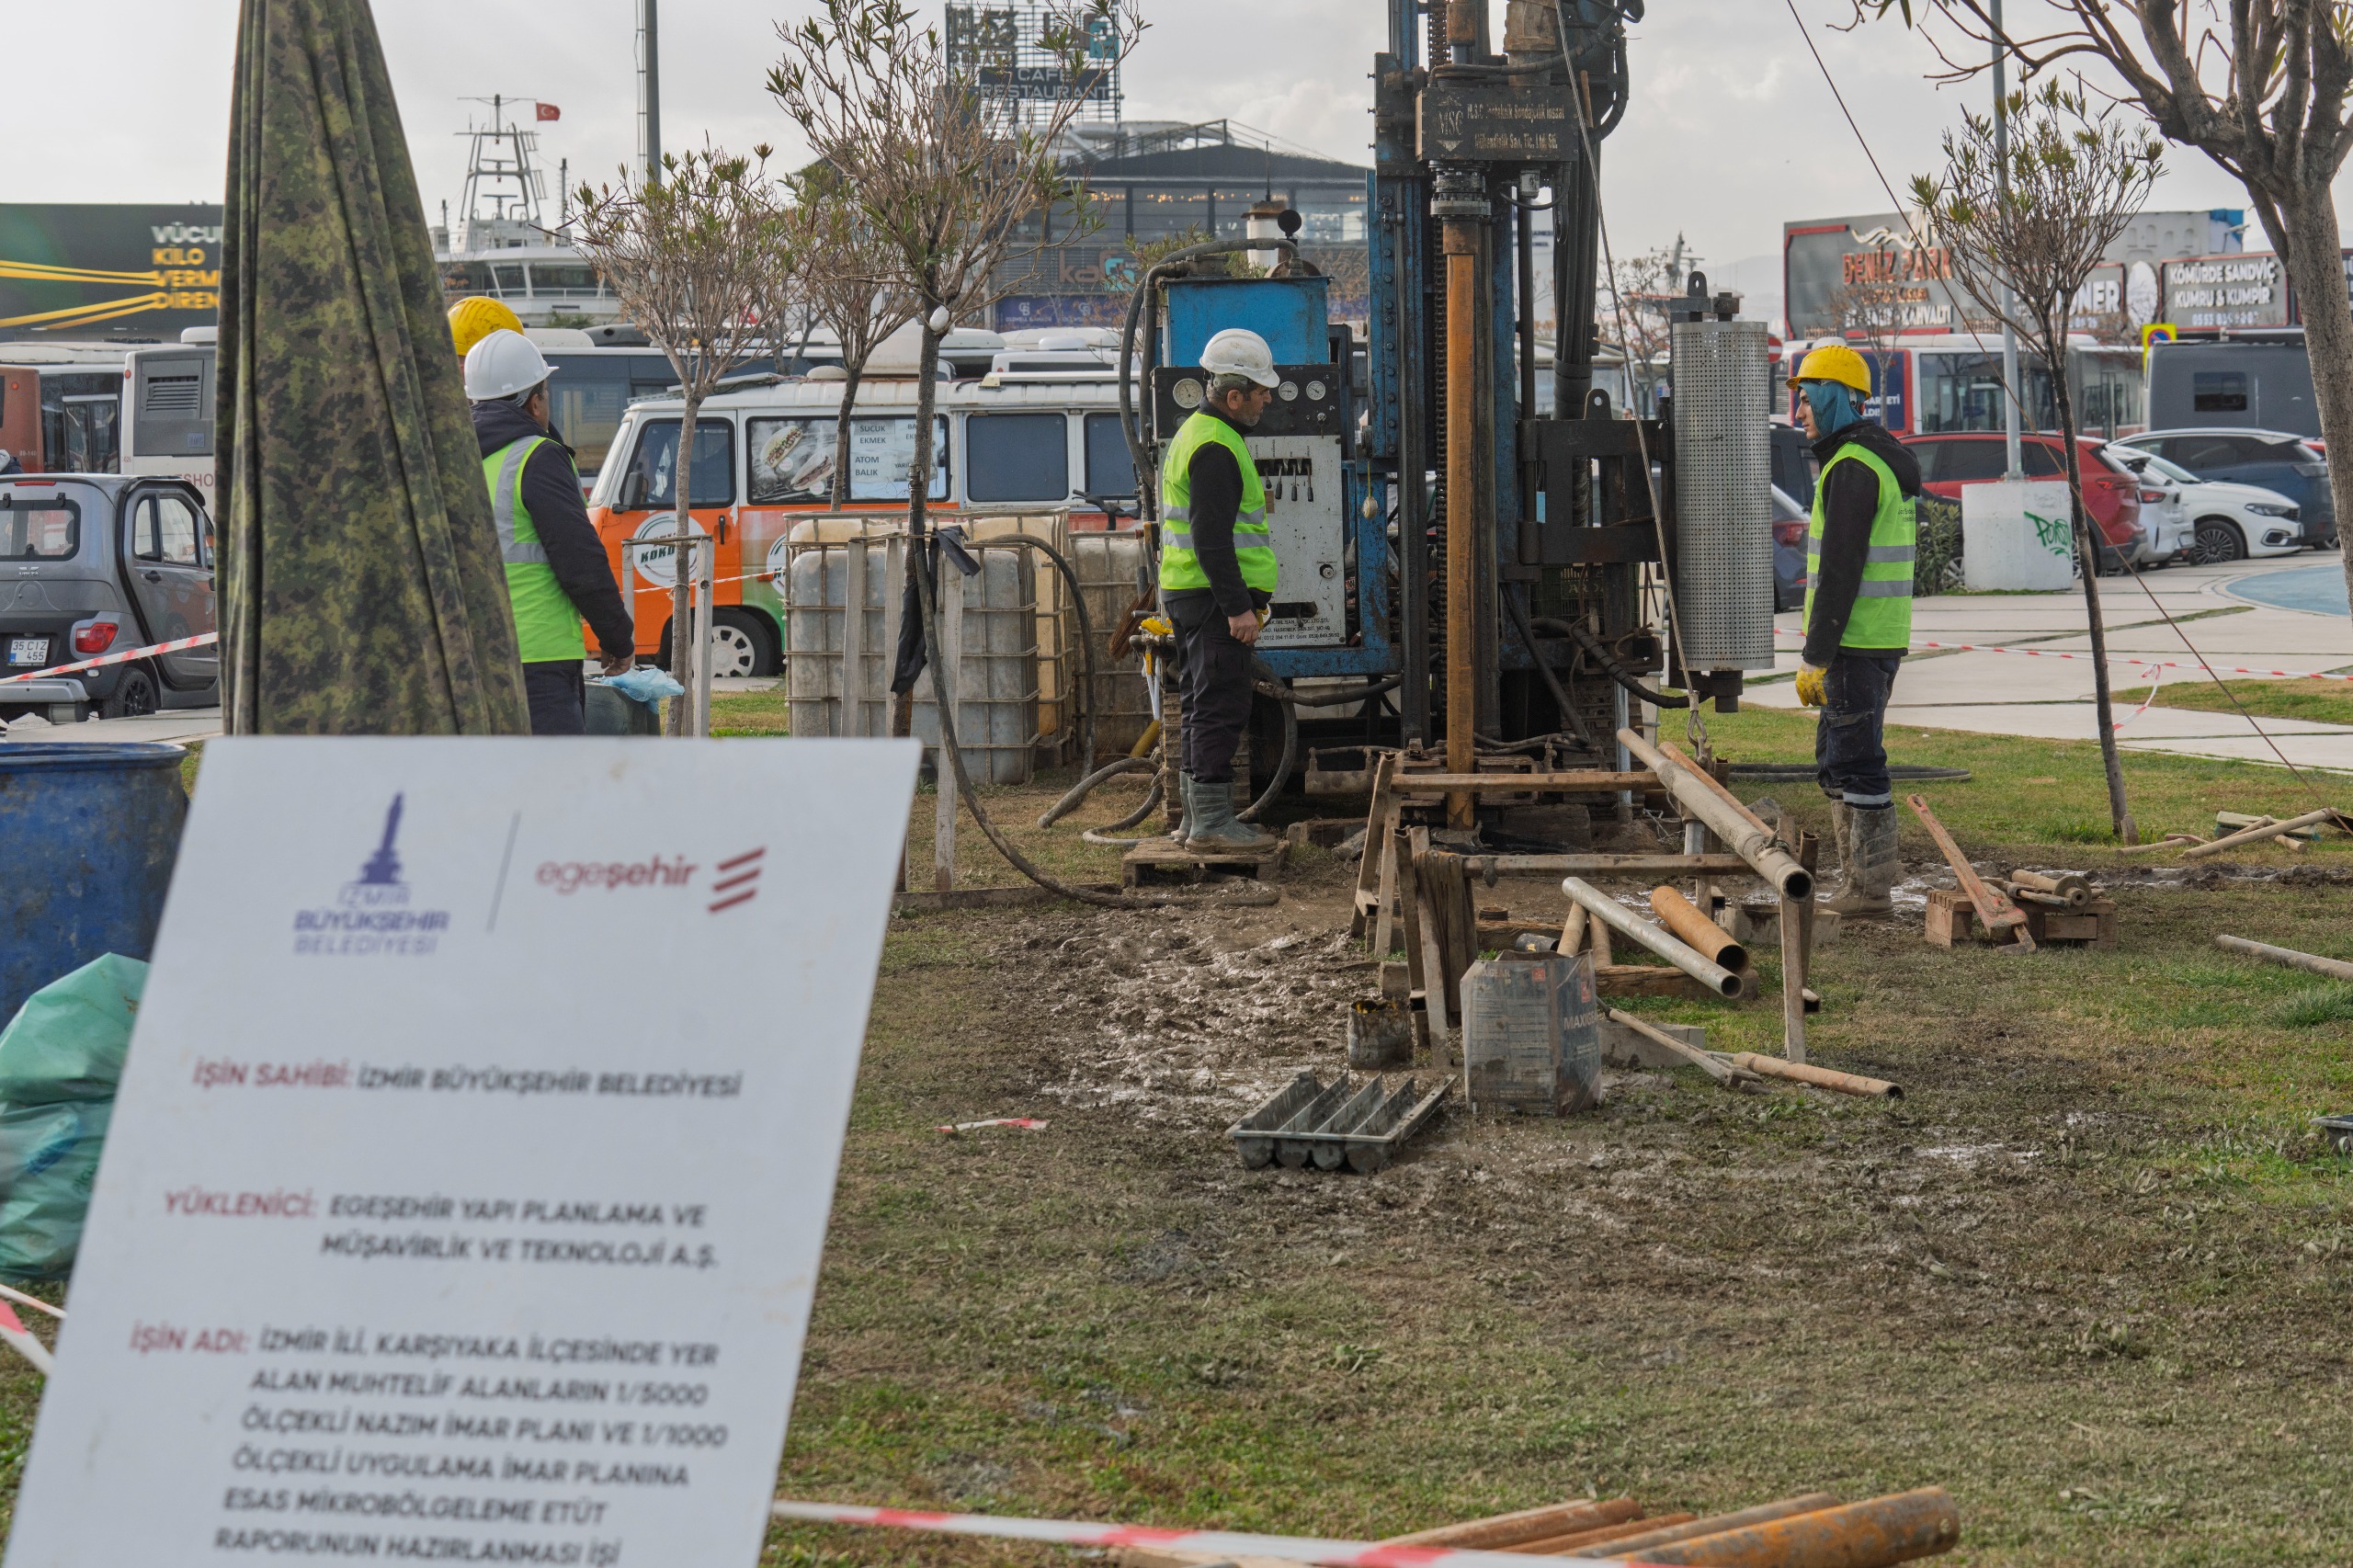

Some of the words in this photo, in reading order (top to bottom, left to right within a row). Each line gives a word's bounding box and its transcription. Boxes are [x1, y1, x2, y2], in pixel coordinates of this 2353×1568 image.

[1017, 67, 1072, 82] CAFE
[980, 85, 1108, 100] RESTAURANT
[1842, 244, 1895, 285] DENİZ
[1902, 246, 1953, 282] PARK
[2168, 263, 2223, 285] KÖMÜRDE
[2224, 256, 2277, 285] SANDVİÇ
[2175, 289, 2214, 309] KUMRU
[2215, 290, 2225, 307] &
[2226, 282, 2271, 306] KUMPİR
[859, 425, 886, 433] SUCUK
[175, 472, 216, 487] SHO
[641, 545, 676, 564] KOKO
[12, 641, 25, 651] 35
[27, 641, 47, 651] CIZ
[27, 652, 44, 661] 455
[537, 855, 698, 894] egeşehir
[293, 905, 450, 933] BÜYÜKŞEHİR
[293, 933, 438, 957] BELEDİYESİ
[193, 1057, 247, 1090] İŞİN
[255, 1057, 353, 1088] SAHİBİ:
[357, 1062, 426, 1091] İZMİR
[429, 1062, 593, 1098] BÜYÜKŞEHİR
[597, 1067, 745, 1098] BELEDİYESİ
[165, 1186, 317, 1218] YÜKLENİCİ:
[329, 1192, 454, 1222] EGEŞEHİR
[461, 1198, 517, 1222] YAPI
[521, 1199, 664, 1227] PLANLAMA
[674, 1203, 707, 1229] VE
[322, 1228, 472, 1263] MÜŞAVİRLİK
[480, 1238, 513, 1263] VE
[520, 1236, 666, 1267] TEKNOLOJİ
[668, 1243, 720, 1270] A.Ş.
[131, 1321, 187, 1356] İŞİN
[192, 1327, 248, 1355] ADI:
[258, 1324, 328, 1355] İZMİR
[375, 1333, 520, 1361] KARŞIYAKA
[527, 1332, 663, 1366] İLÇESİNDE
[670, 1342, 720, 1368] YER
[249, 1369, 320, 1392] ALAN
[325, 1368, 452, 1398] MUHTELİF
[458, 1373, 608, 1403] ALANLARIN
[615, 1381, 710, 1407] 1/5000
[241, 1403, 350, 1436] ÖLÇEKLİ
[354, 1411, 438, 1438] NAZIM
[442, 1410, 509, 1440] İMAR
[516, 1418, 594, 1445] PLANI
[601, 1421, 634, 1446] VE
[642, 1423, 729, 1450] 1/1000
[231, 1442, 343, 1476] ÖLÇEKLİ
[346, 1451, 494, 1482] UYGULAMA
[501, 1451, 568, 1483] İMAR
[574, 1460, 689, 1488] PLANINA
[222, 1486, 290, 1513] ESAS
[295, 1485, 536, 1523] MİKROBÖLGELEME
[540, 1494, 609, 1526] ETÜT
[213, 1527, 382, 1558] RAPORUNUN
[385, 1534, 583, 1565] HAZIRLANMASI
[586, 1536, 624, 1568] İŞİ
